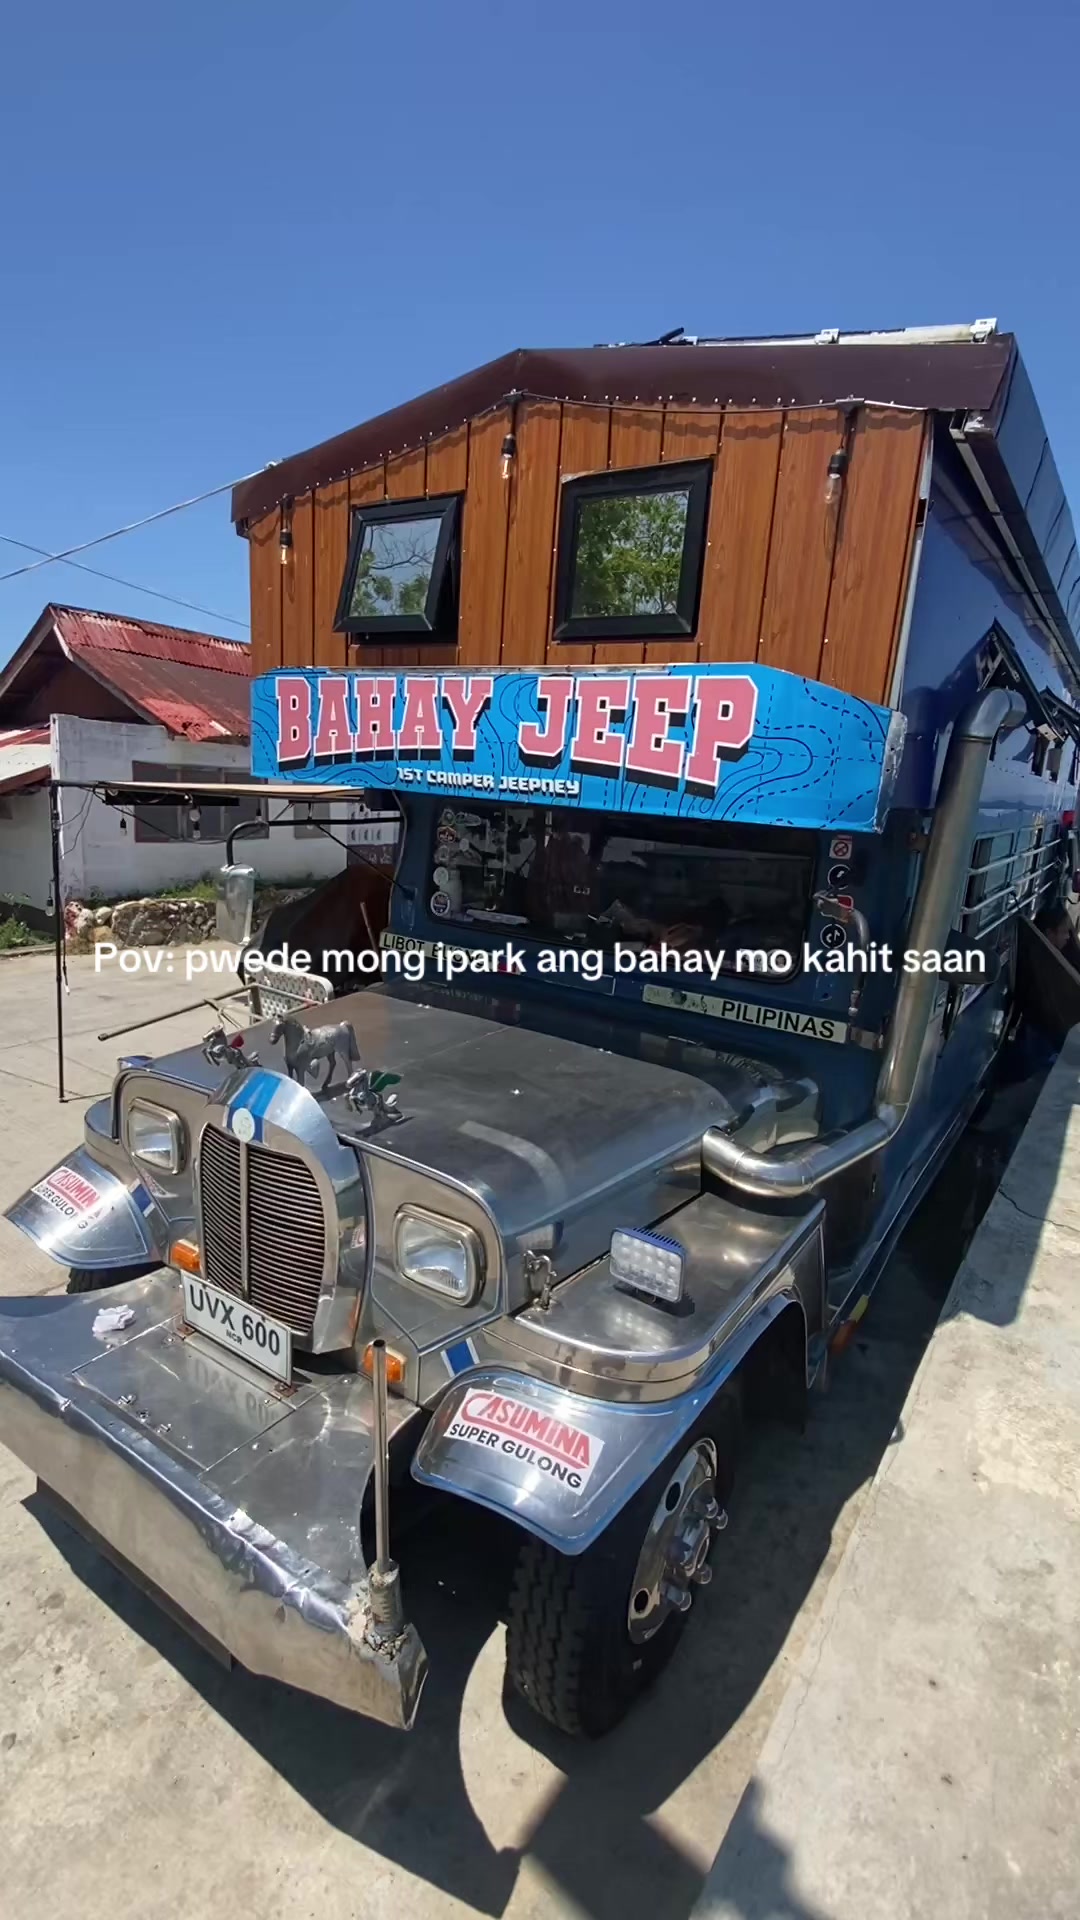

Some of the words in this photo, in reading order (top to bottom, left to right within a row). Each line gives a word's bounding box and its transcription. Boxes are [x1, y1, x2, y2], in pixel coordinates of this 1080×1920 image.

[276, 676, 494, 769] BAHAY
[517, 675, 759, 795] JEEP
[397, 767, 423, 783] 1ST
[426, 770, 495, 791] CAMPER
[498, 776, 580, 797] JEEPNEY
[383, 933, 425, 952] LIBOT
[721, 1000, 835, 1039] PILIPINAS
[189, 1283, 236, 1331] UVX
[241, 1314, 280, 1356] 600
[449, 1423, 500, 1449] SUPER
[501, 1439, 583, 1490] GULONG
[460, 1392, 591, 1470] CASUMINA
